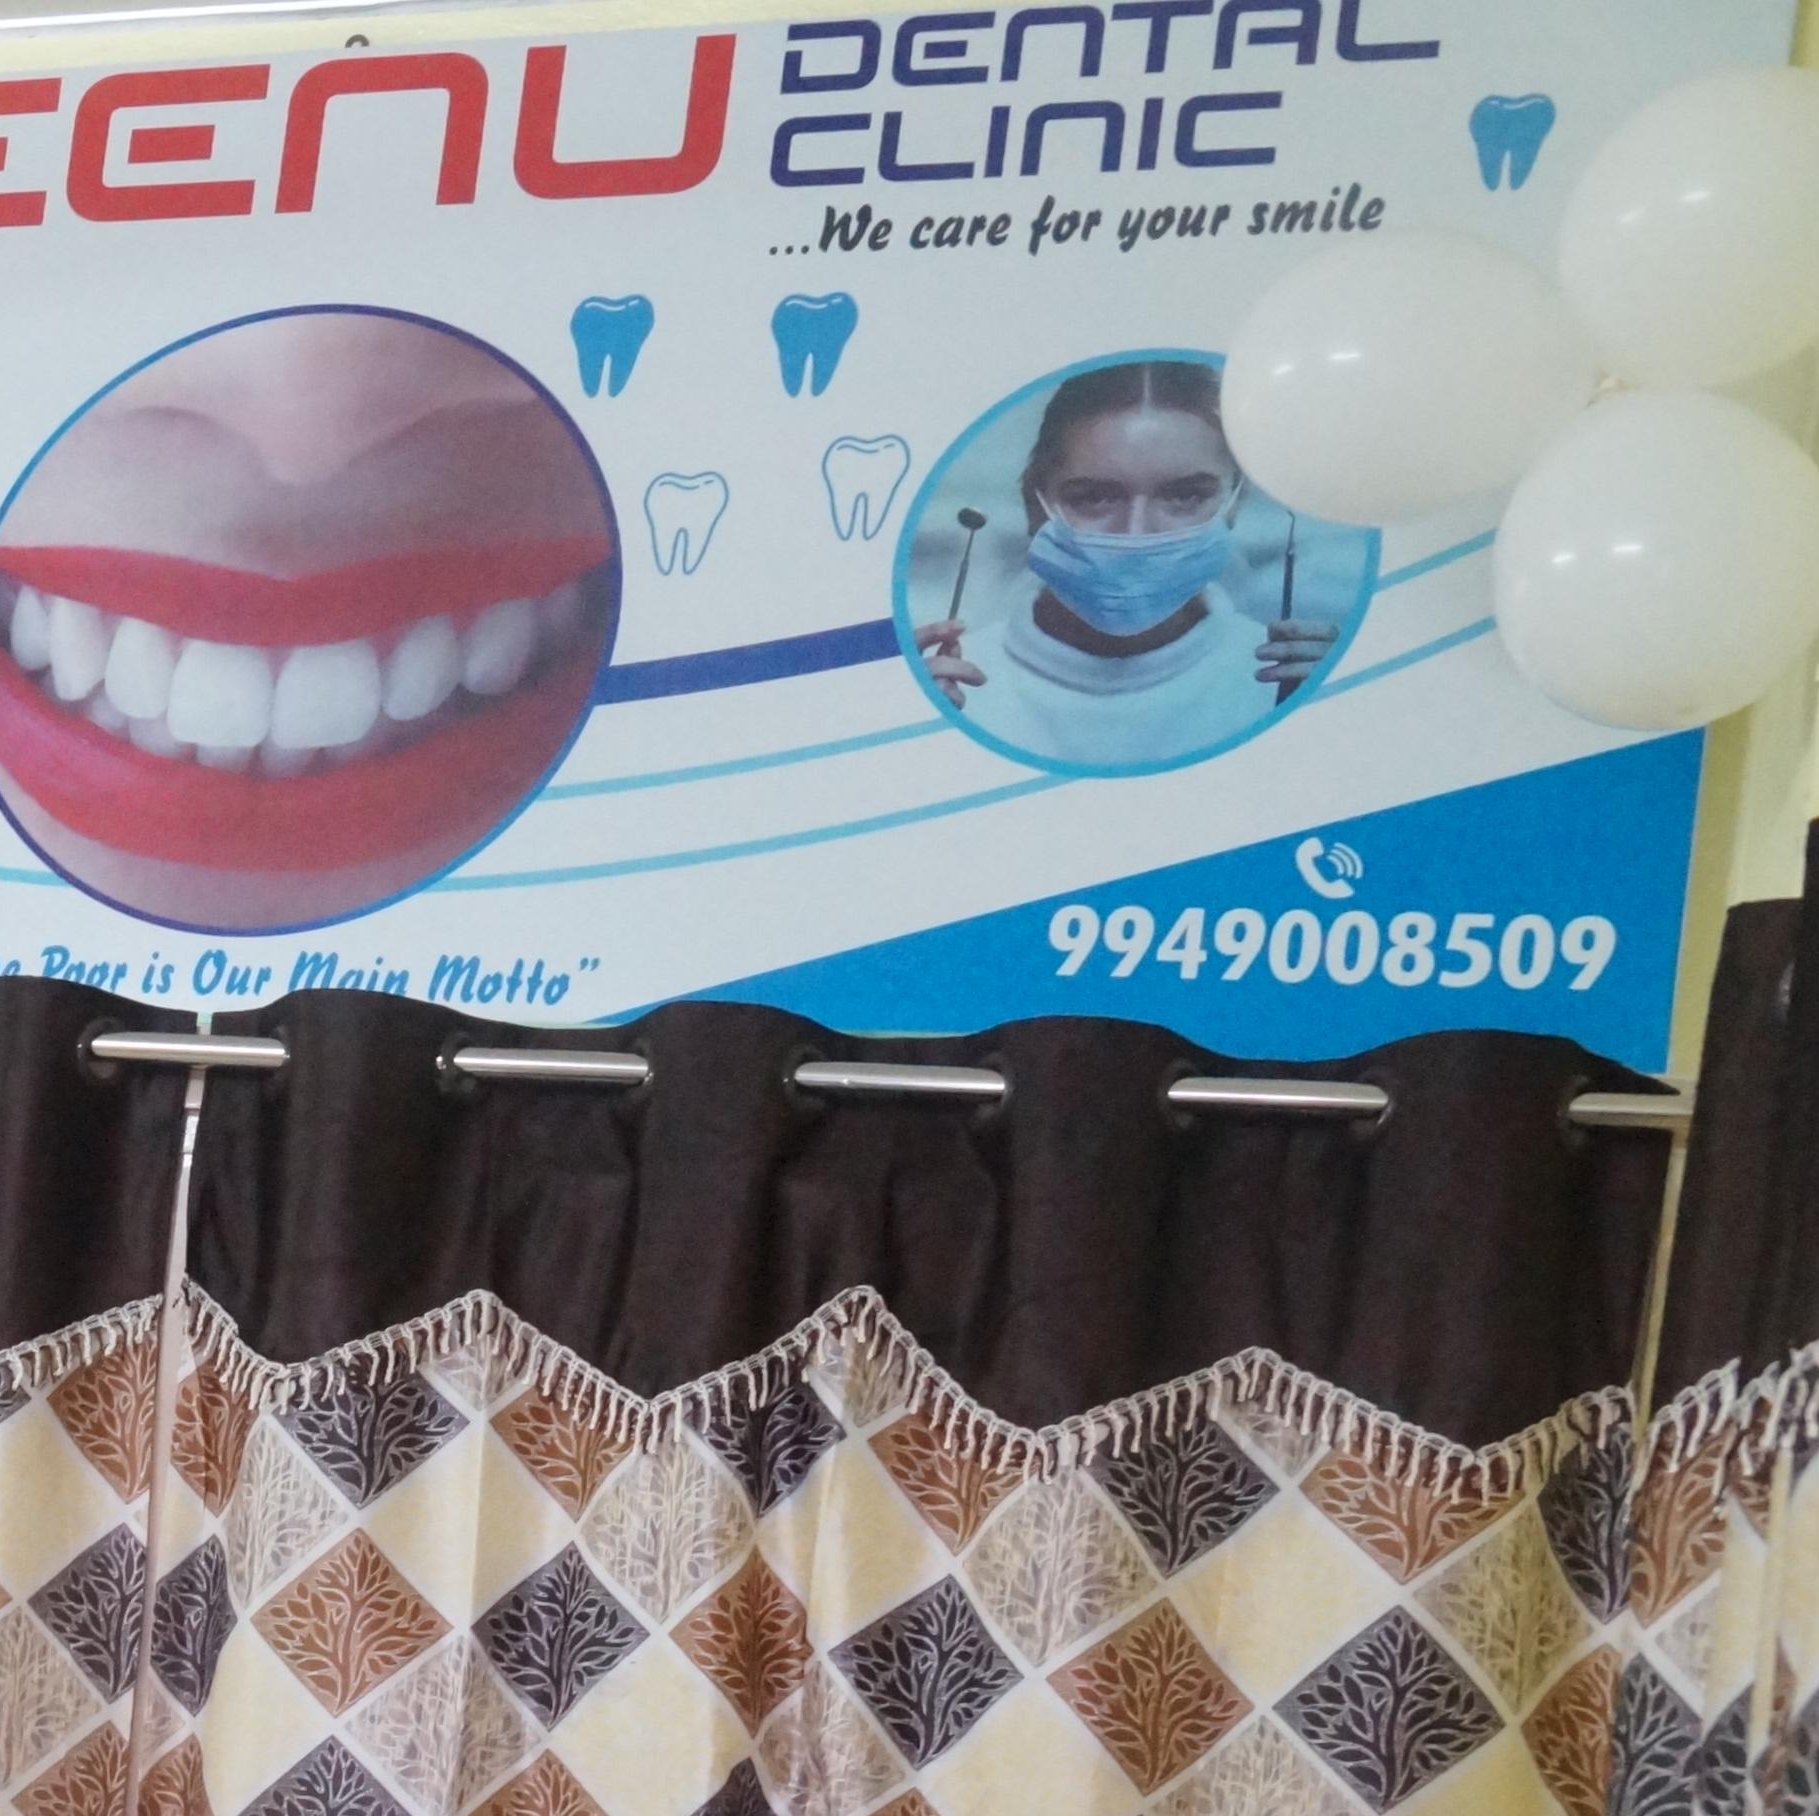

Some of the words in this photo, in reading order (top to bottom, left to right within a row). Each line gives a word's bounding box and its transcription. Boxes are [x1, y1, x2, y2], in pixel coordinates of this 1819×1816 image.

[780, 0, 1441, 94] DENTAL
[770, 91, 1282, 187] CLINIC
[908, 210, 1013, 251] care
[1027, 194, 1102, 257] for
[1117, 202, 1231, 253] your
[1246, 183, 1387, 236] smile
[141, 950, 175, 996] is
[191, 949, 273, 997] Our
[287, 949, 410, 998] Main
[1047, 904, 1617, 992] 9949008509
